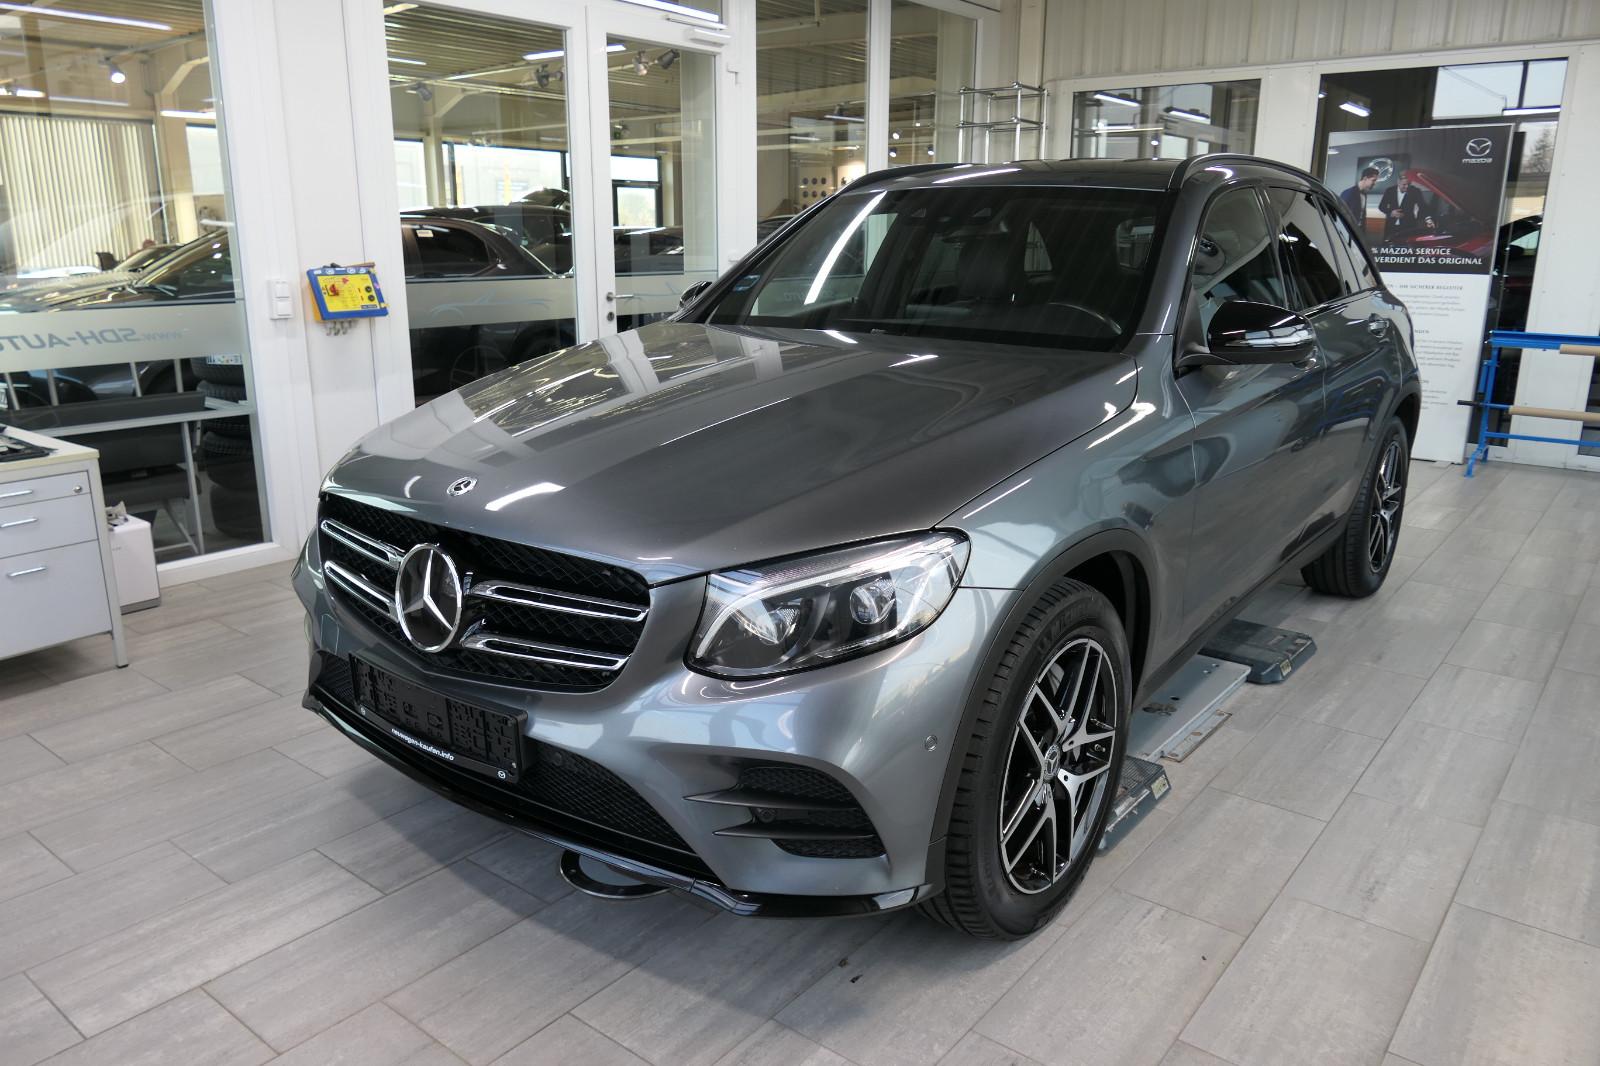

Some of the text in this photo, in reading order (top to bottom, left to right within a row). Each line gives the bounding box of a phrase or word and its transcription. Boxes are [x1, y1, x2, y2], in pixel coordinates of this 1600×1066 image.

[1380, 247, 1413, 255] MAZDA
[1415, 247, 1452, 256] SERVICE
[1374, 256, 1483, 265] VERDIENT DAS ORIGINAL
[391, 728, 455, 761] neuwagen-kaufen.info
